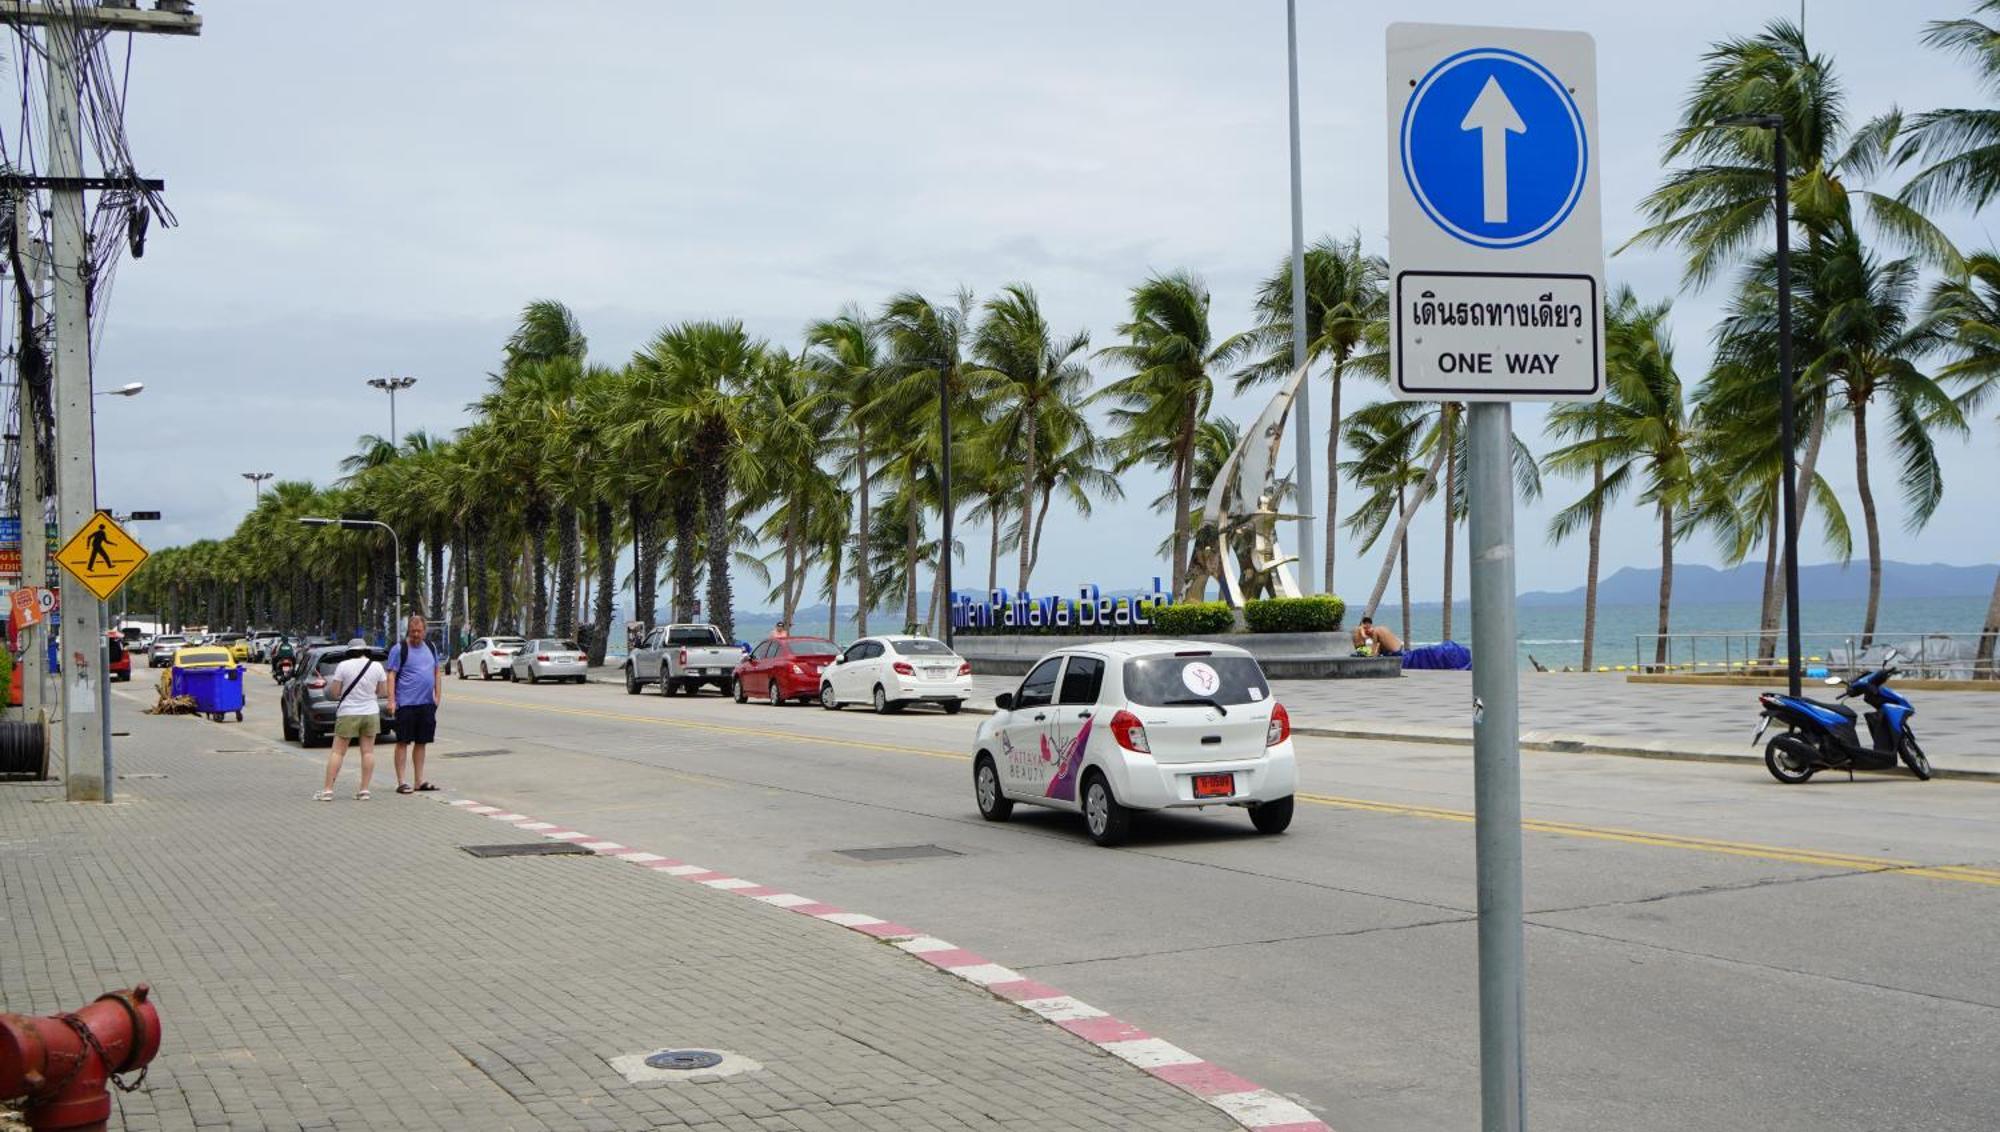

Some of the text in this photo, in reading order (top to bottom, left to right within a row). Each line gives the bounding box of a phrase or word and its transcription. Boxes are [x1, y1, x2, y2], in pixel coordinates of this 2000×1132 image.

[1413, 290, 1582, 327] เดินรถทางเดียว
[1438, 352, 1560, 374] ONE WAY
[991, 588, 1070, 626] Pattaya
[1079, 577, 1172, 626] Beach
[1008, 751, 1044, 767] PATTAYA
[1010, 764, 1044, 781] BEAUTY
